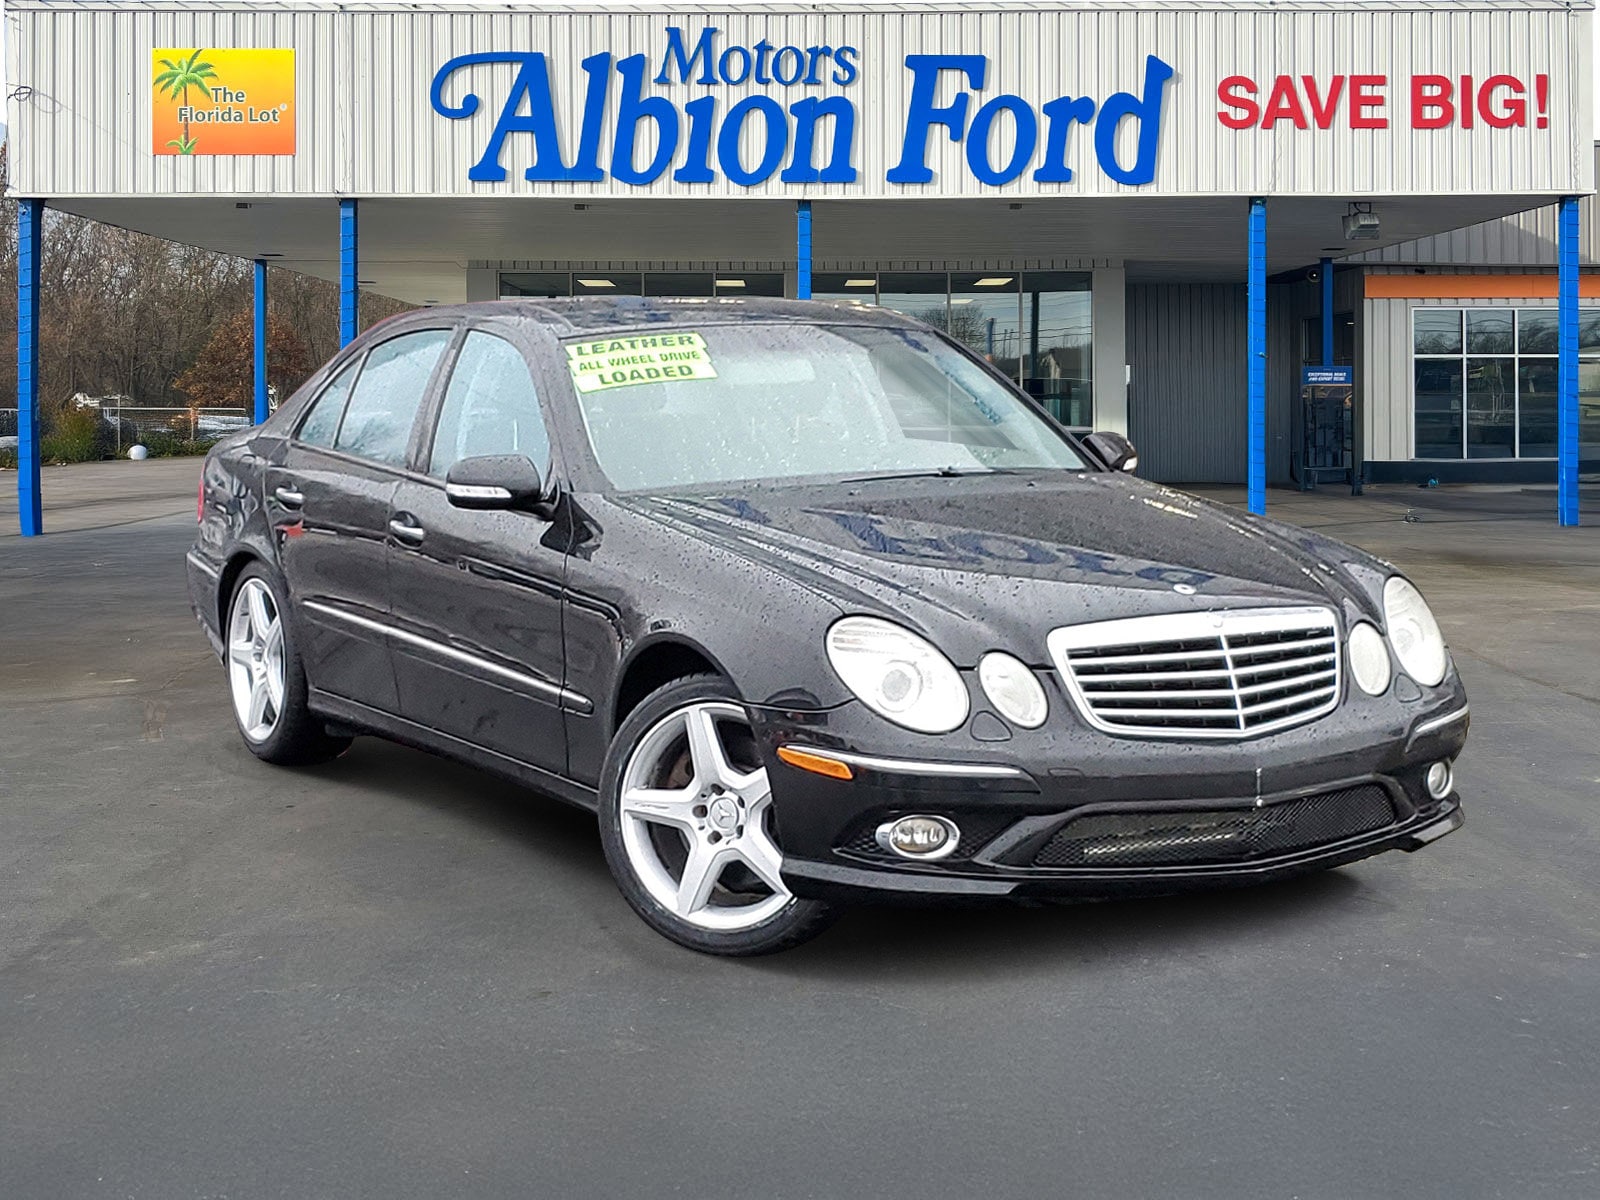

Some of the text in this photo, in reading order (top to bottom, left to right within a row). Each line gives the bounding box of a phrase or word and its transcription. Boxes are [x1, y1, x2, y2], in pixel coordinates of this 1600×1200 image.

[653, 26, 858, 86] Motors
[210, 86, 246, 104] The
[1217, 74, 1548, 129] SAVE BIG!
[177, 106, 244, 123] Florida
[430, 51, 1174, 186] Albion Ford
[576, 335, 695, 356] LEATHER
[579, 350, 700, 371] ALL WHEEL DRIVE
[598, 364, 694, 385] LOADED
